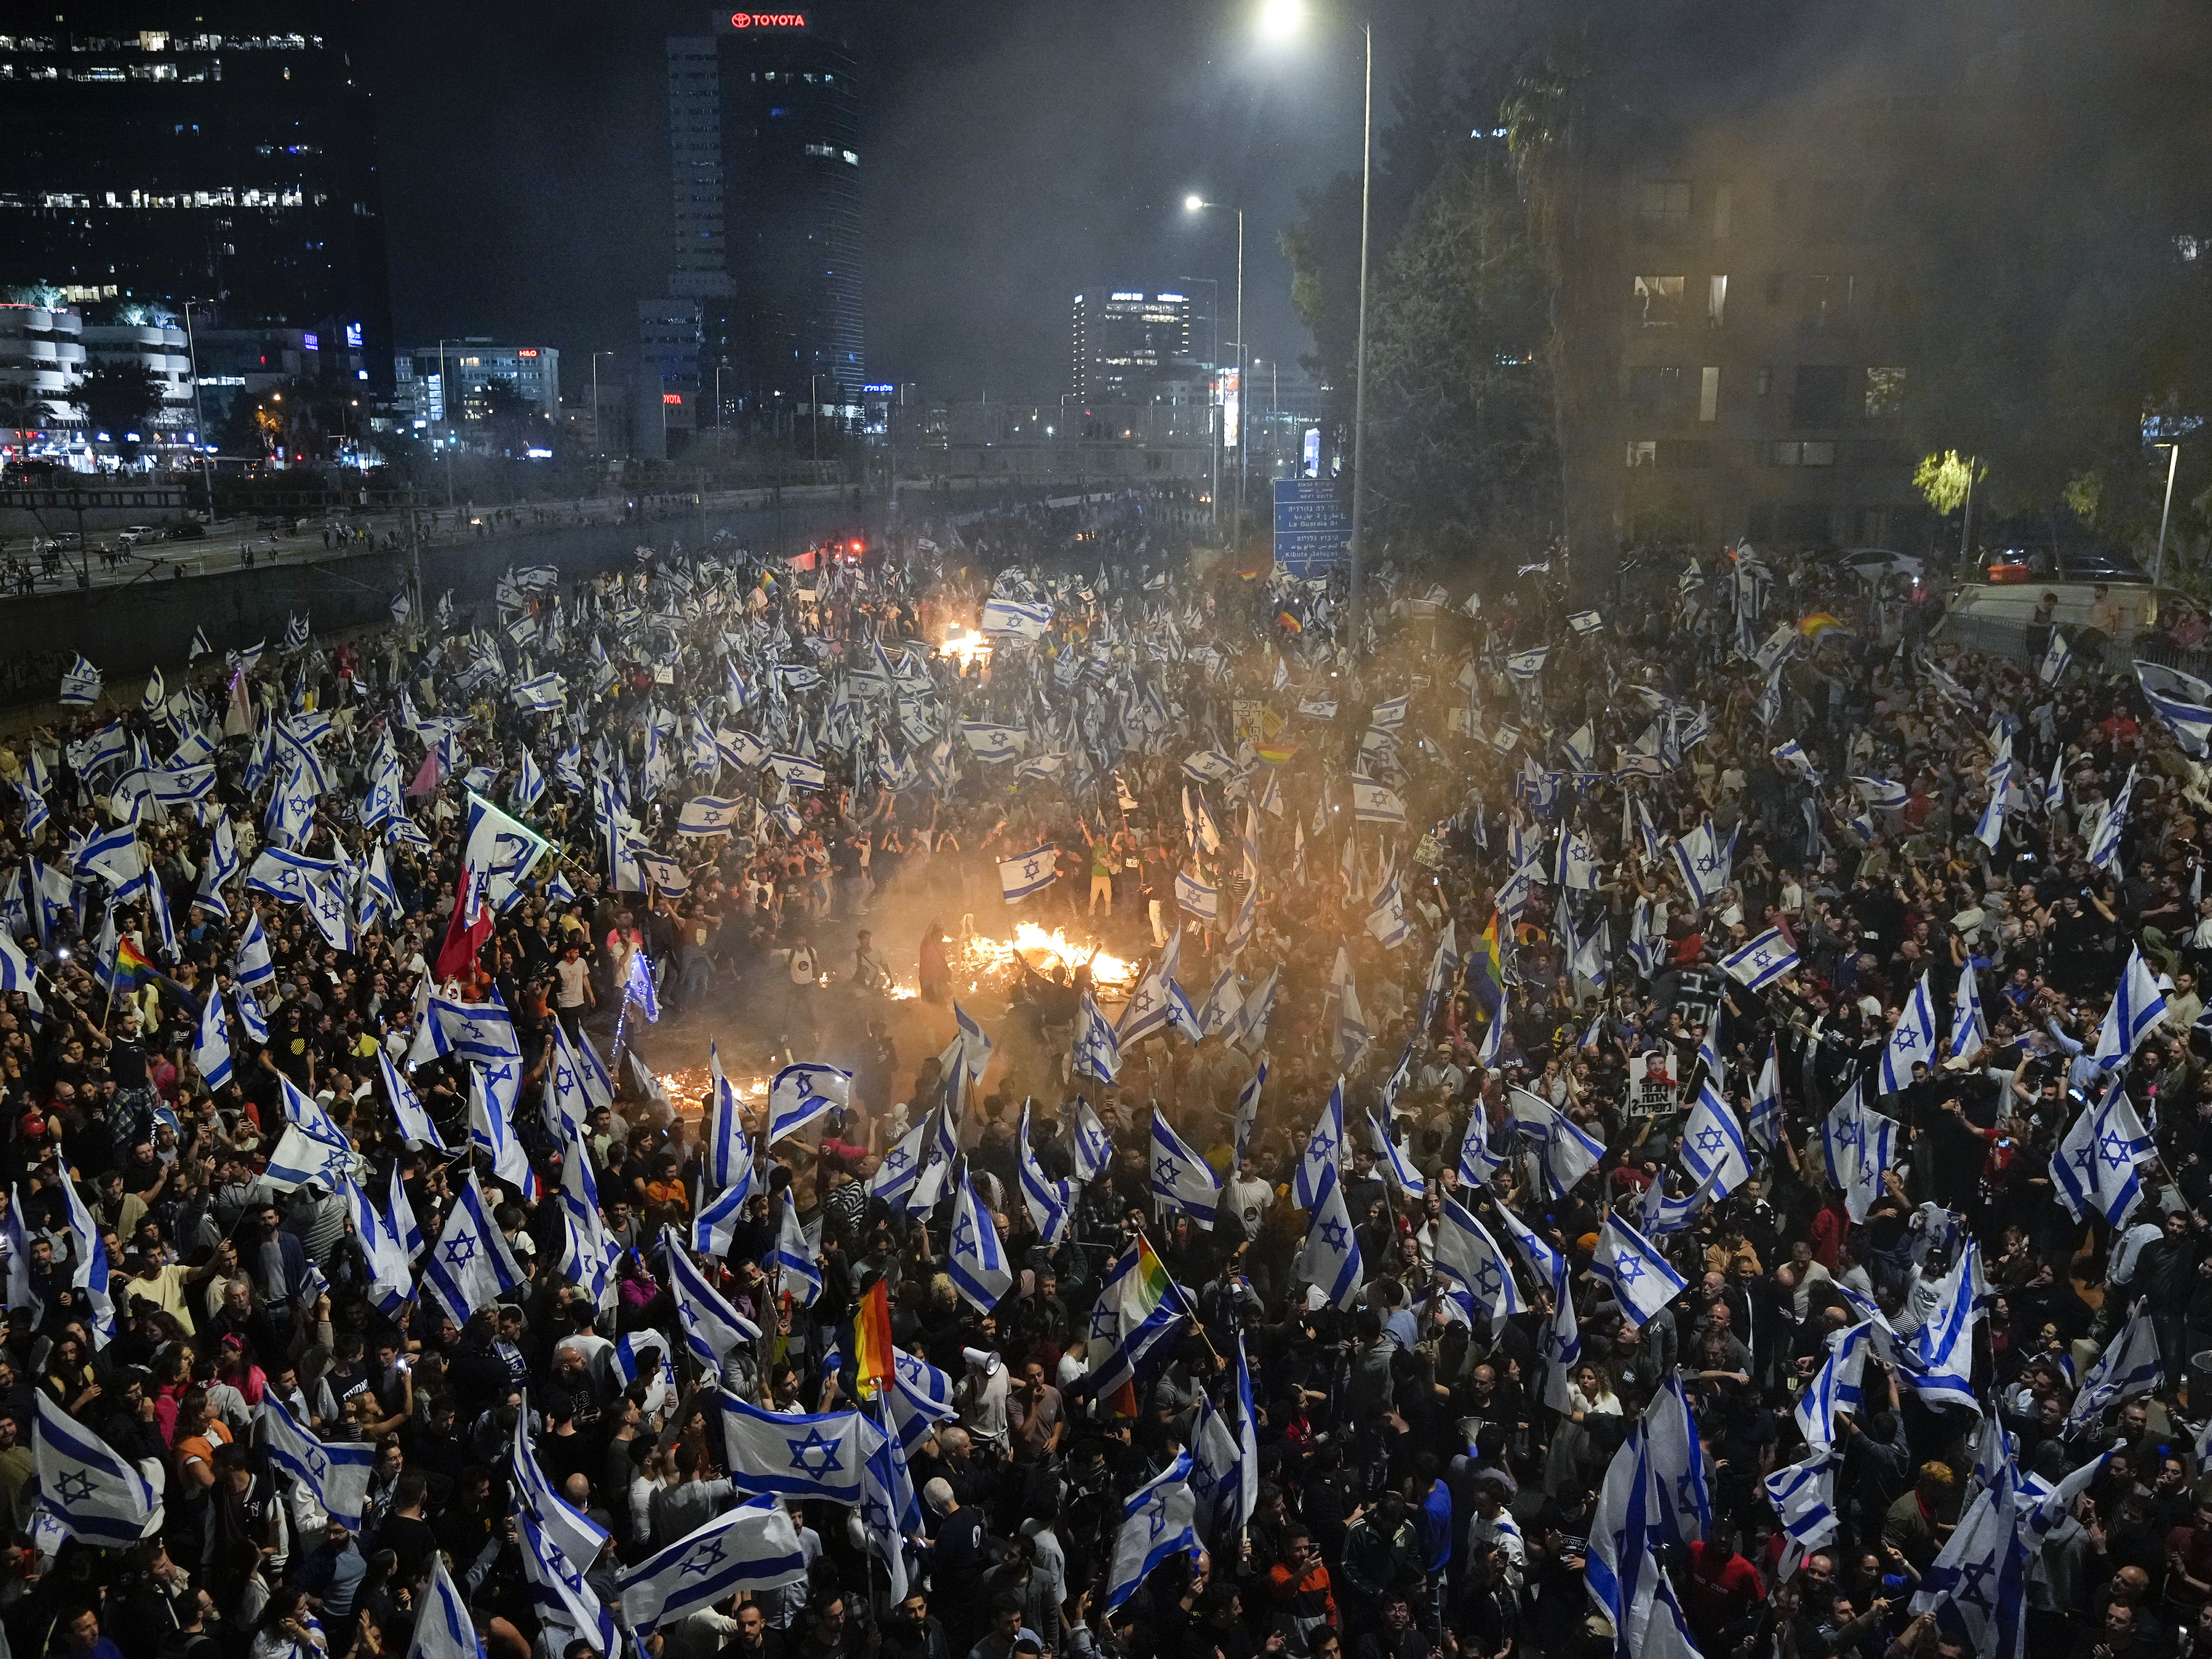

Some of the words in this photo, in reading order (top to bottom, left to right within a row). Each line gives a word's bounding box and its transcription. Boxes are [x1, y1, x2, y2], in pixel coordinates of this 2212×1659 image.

[752, 15, 805, 26] TOYOTA
[663, 394, 682, 404] OYOTA
[1238, 701, 1258, 709] אולי
[1642, 1084, 1668, 1093] ממה
[1642, 1093, 1668, 1103] אתה
[1632, 1099, 1672, 1114] מפחד?
